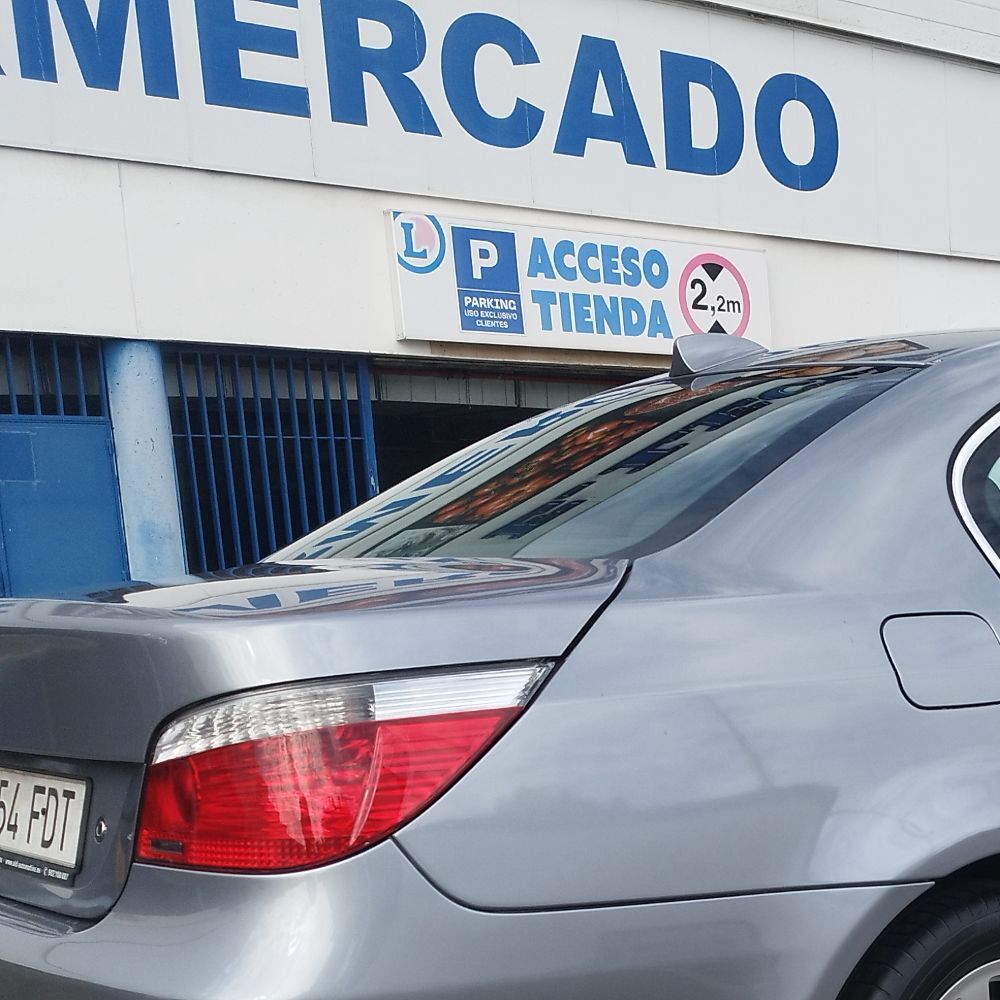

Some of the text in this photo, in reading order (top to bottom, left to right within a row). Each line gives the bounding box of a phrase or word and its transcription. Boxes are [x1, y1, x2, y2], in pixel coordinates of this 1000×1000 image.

[0, 0, 839, 192] MERCADO
[469, 239, 499, 280] P
[526, 236, 670, 290] ACCESO
[464, 296, 517, 311] PARKING
[464, 308, 518, 321] USO EXCLUSIVO
[475, 319, 509, 329] CLIENTES
[530, 289, 674, 340] TIENDA
[26, 784, 76, 852] FDT
